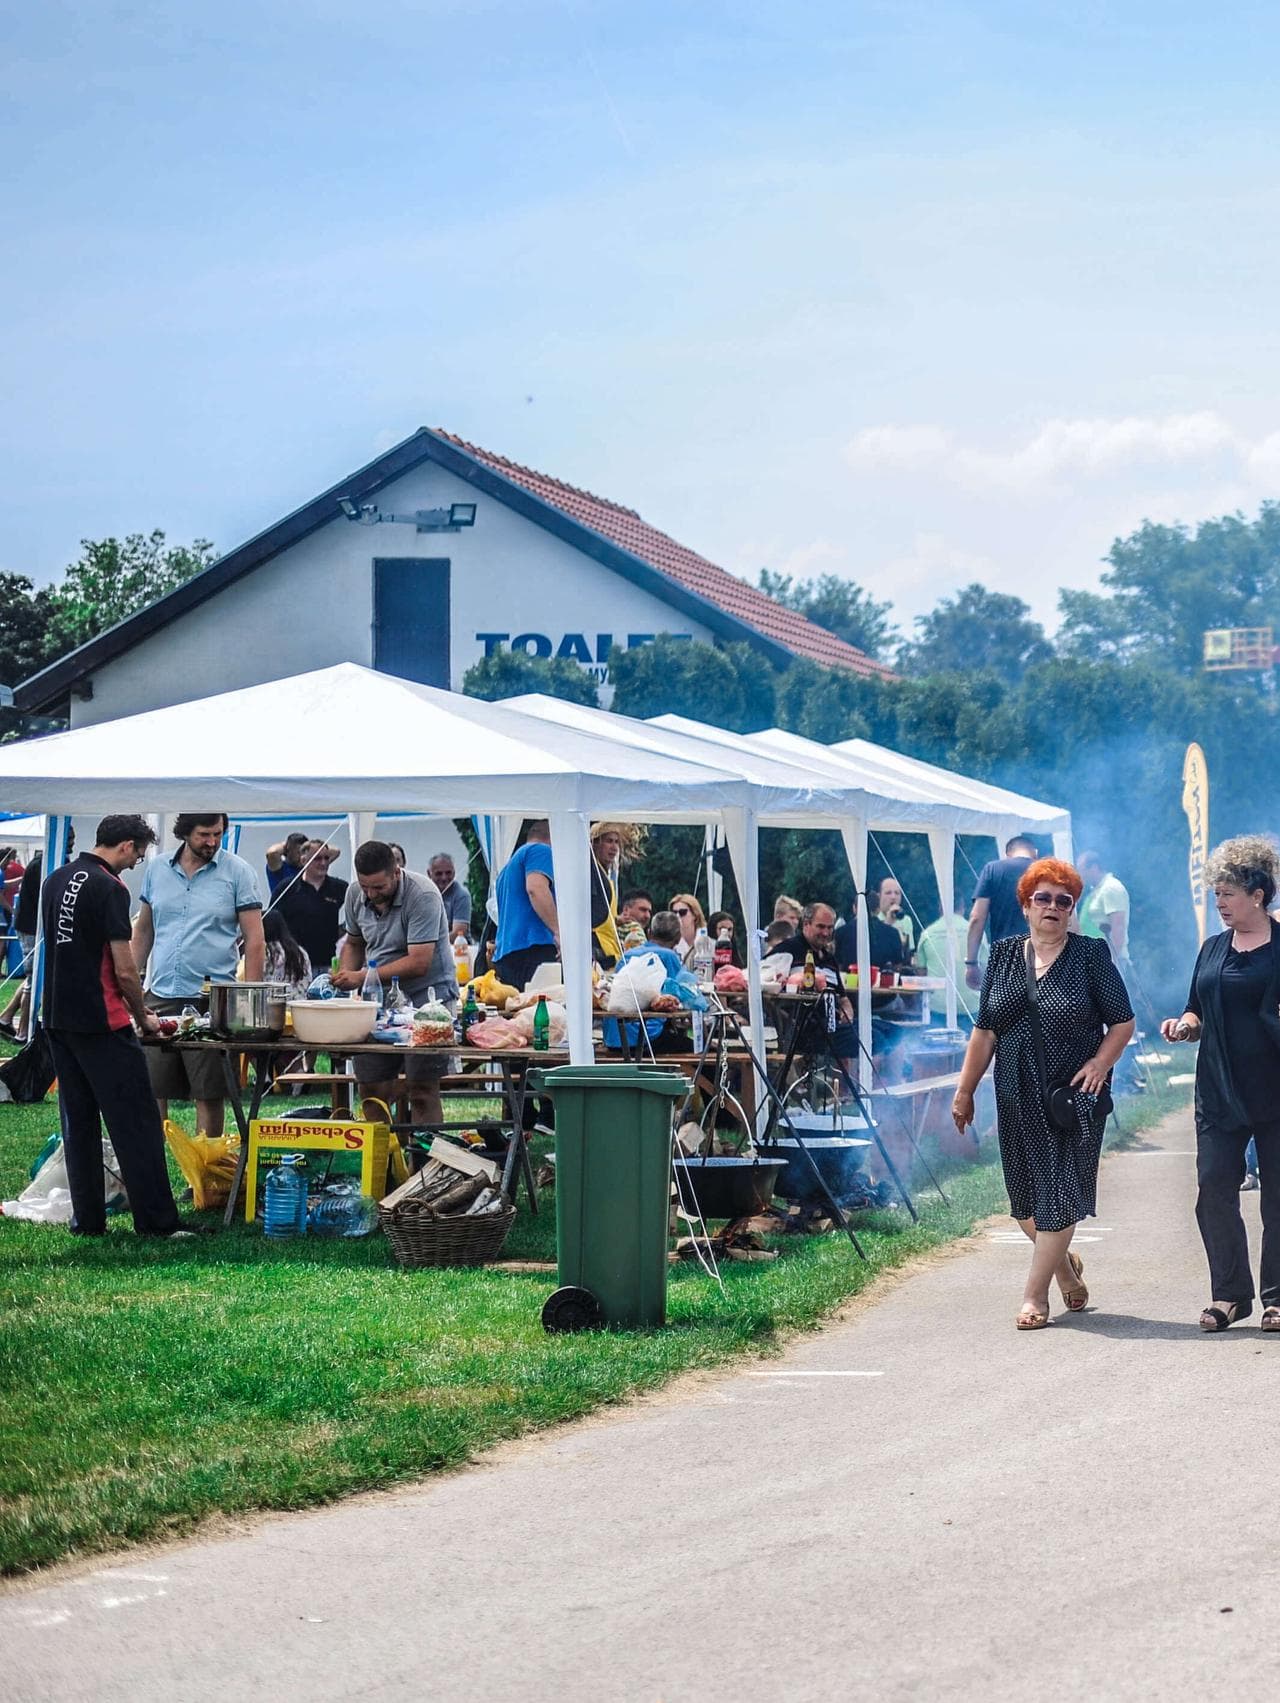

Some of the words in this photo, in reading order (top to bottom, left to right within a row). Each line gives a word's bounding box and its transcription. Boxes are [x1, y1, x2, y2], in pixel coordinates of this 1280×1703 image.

[476, 633, 692, 663] TOAL
[56, 870, 89, 945] СРБИЈА
[259, 1122, 364, 1149] Sebastijan
